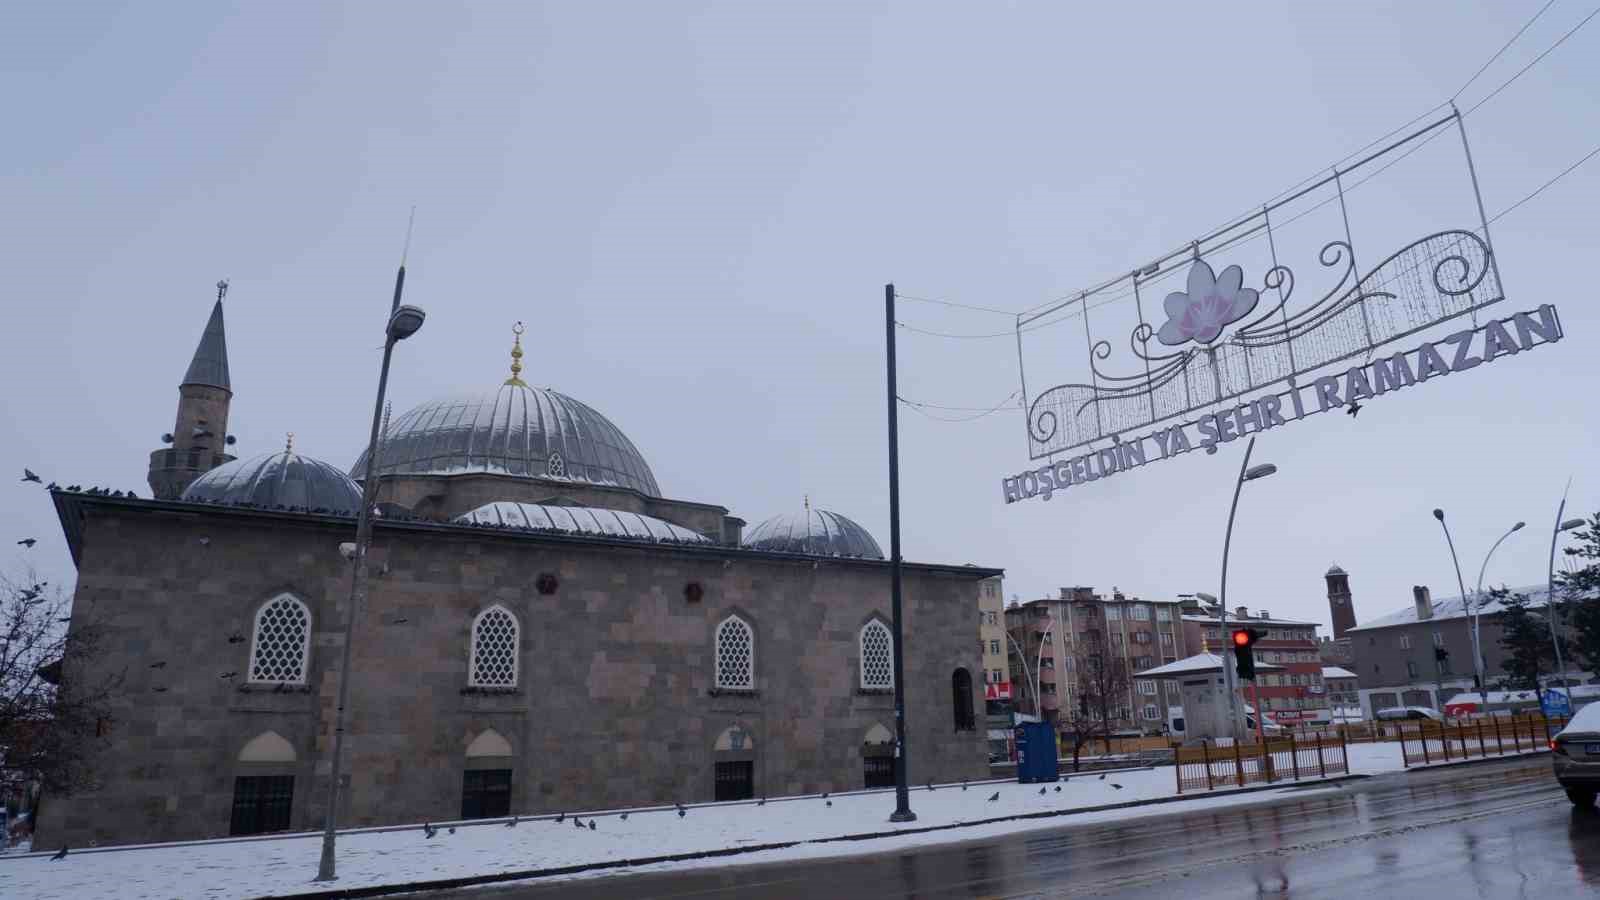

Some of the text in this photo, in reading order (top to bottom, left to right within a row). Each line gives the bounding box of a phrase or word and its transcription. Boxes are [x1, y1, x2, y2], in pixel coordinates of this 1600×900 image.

[1002, 433, 1146, 504] HOŞGELDİN
[1152, 424, 1192, 459] YA
[1314, 304, 1560, 412] RAMAZAN
